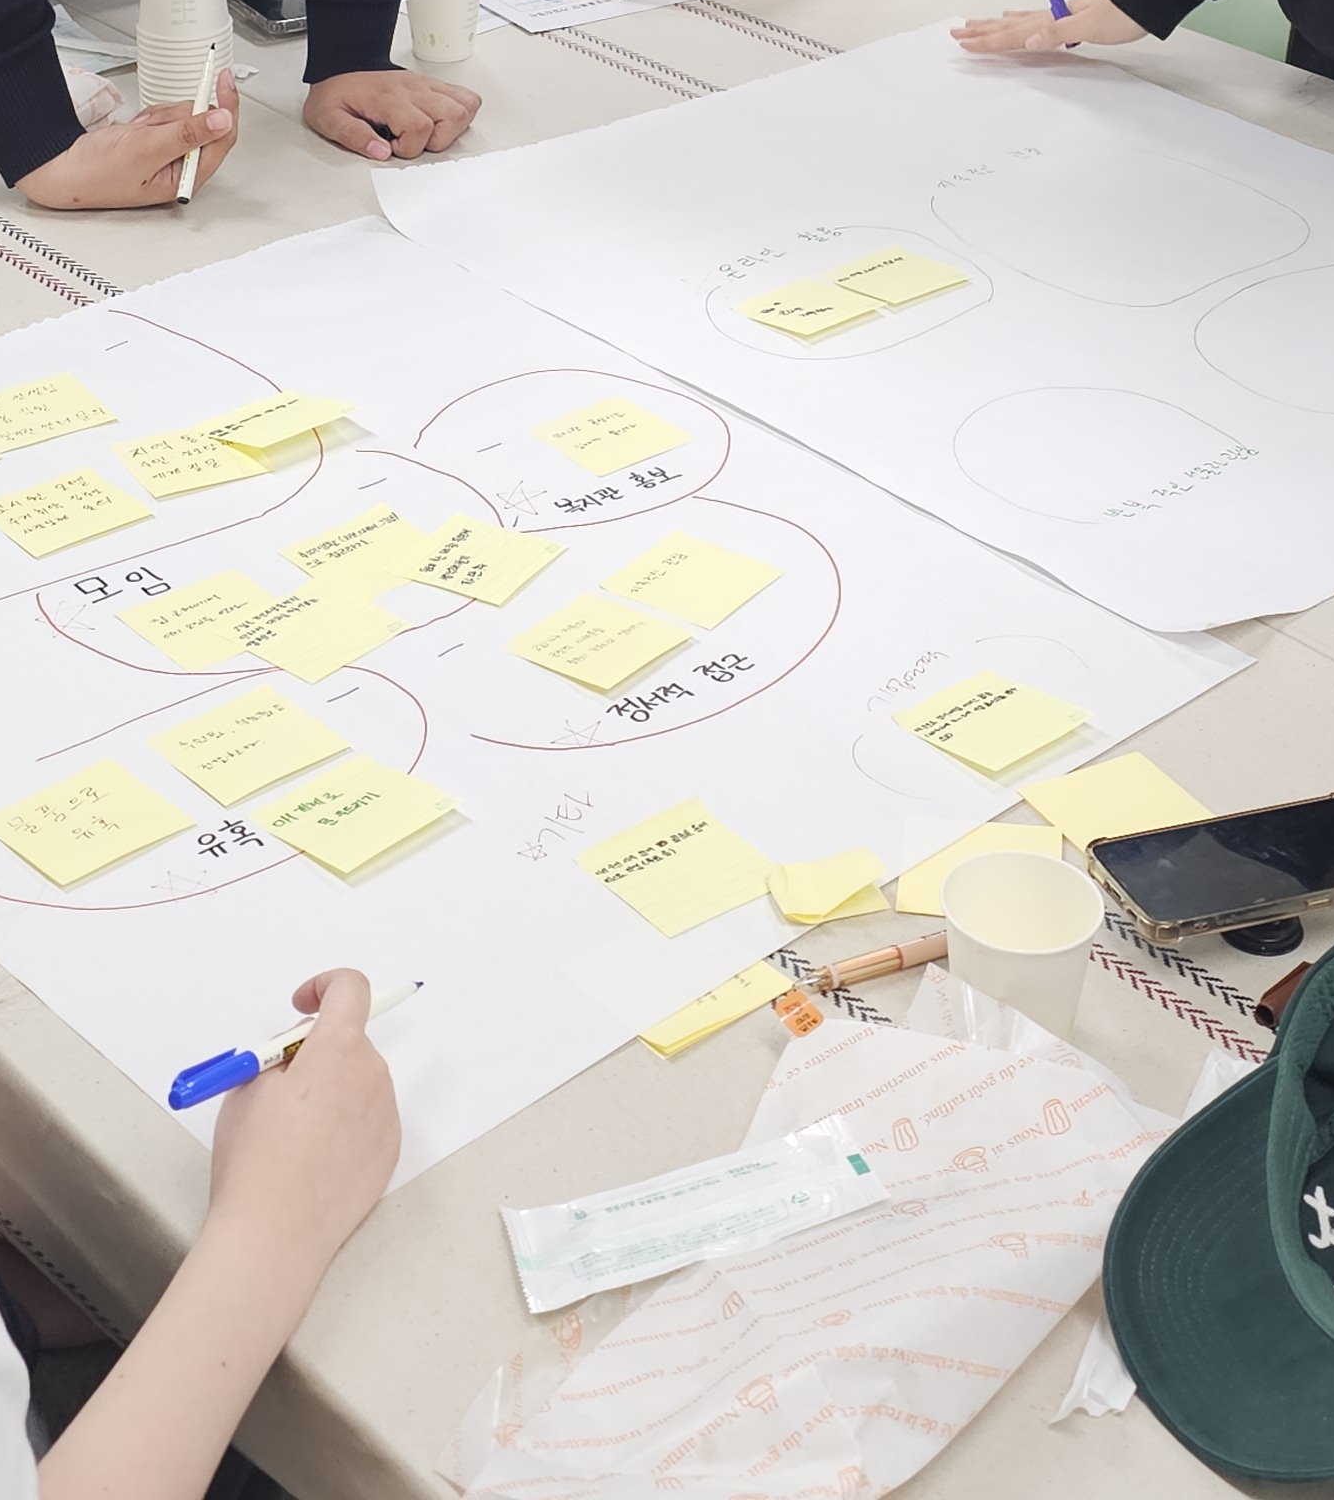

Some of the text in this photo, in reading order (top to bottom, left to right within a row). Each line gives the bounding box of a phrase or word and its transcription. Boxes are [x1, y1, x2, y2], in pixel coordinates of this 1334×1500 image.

[718, 226, 843, 280] 온라인 활용
[12, 383, 58, 401] 선생님
[130, 440, 174, 458] 지역
[152, 468, 183, 480] 에게
[554, 466, 683, 513] 복지관 홍보
[74, 566, 171, 604] 모임
[606, 653, 756, 722] 정서적 접근
[71, 815, 121, 841] 유혹
[197, 819, 265, 859] 유혹
[804, 1028, 875, 1070] transmettre
[866, 1041, 966, 1102] Nous aimerions
[966, 1071, 997, 1101] goût
[999, 1063, 1016, 1082] du
[1013, 1122, 1044, 1147] Nous
